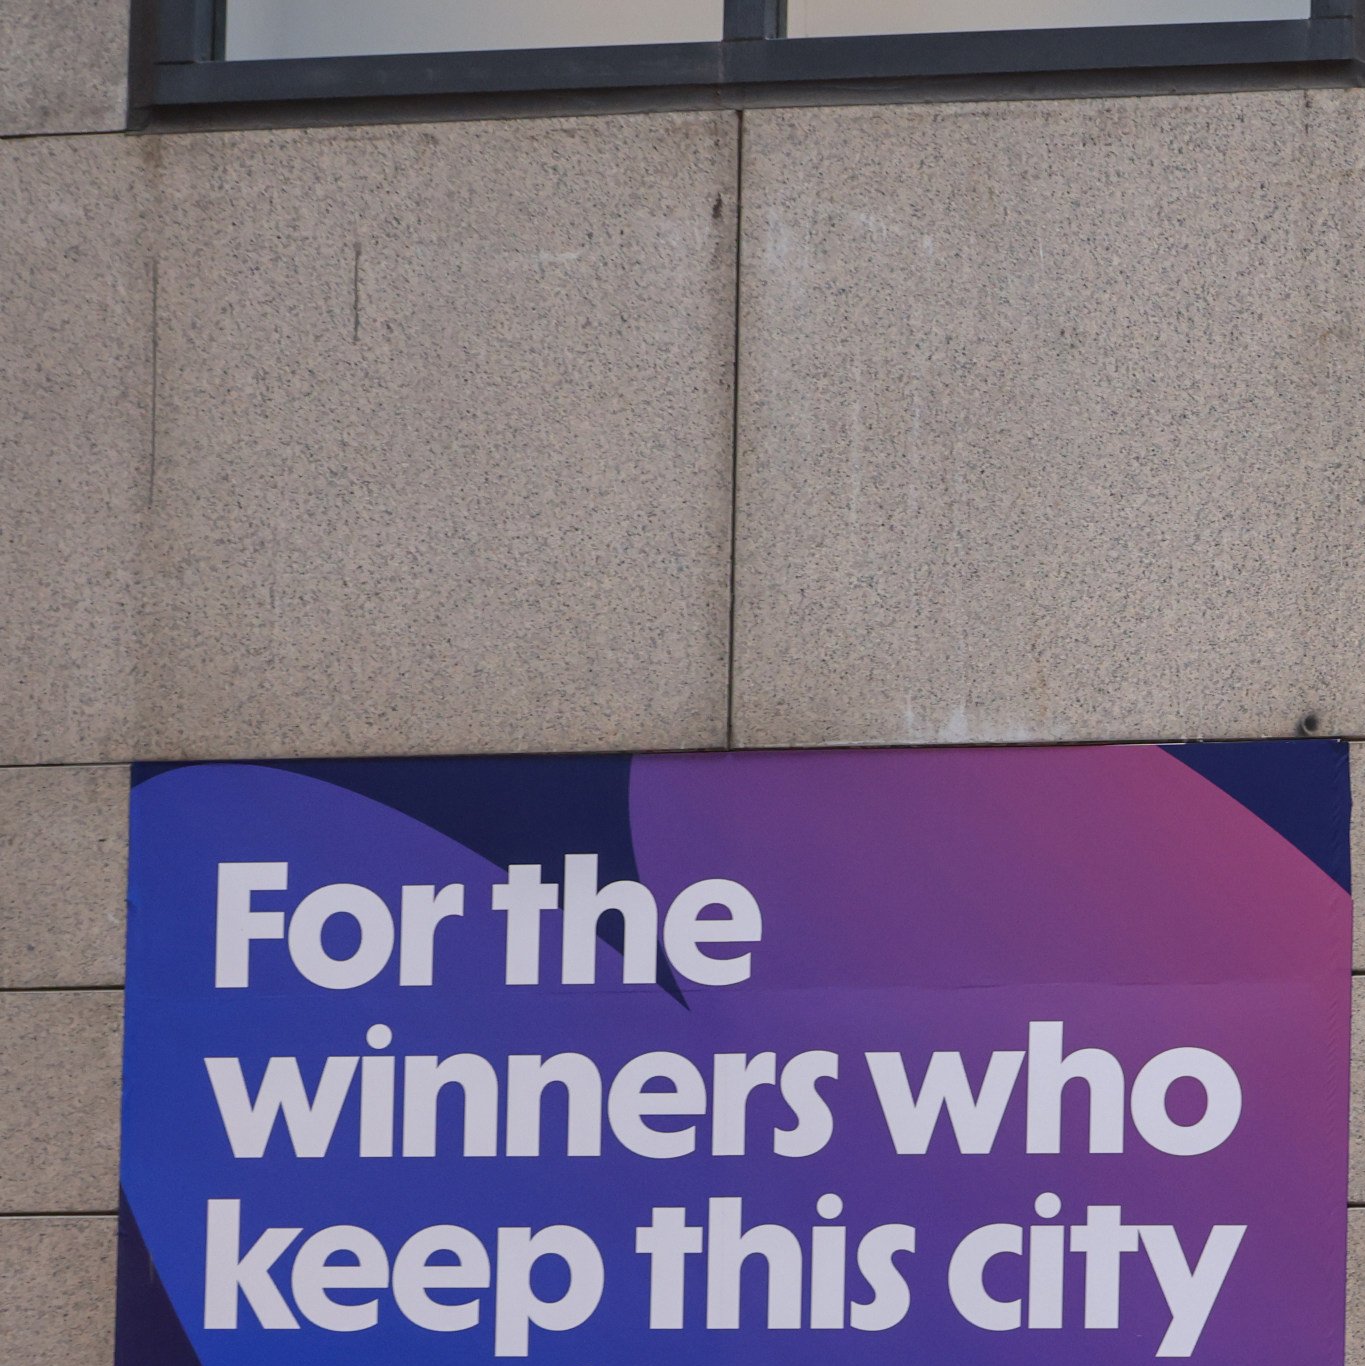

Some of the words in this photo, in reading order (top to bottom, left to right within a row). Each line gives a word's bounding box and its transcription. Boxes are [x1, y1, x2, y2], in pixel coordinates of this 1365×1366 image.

[215, 861, 465, 990] For
[491, 853, 763, 986] the
[203, 1023, 839, 1159] winners
[864, 1020, 1243, 1156] who
[204, 1198, 605, 1357] keep
[635, 1193, 916, 1332] this
[948, 1192, 1248, 1358] city
